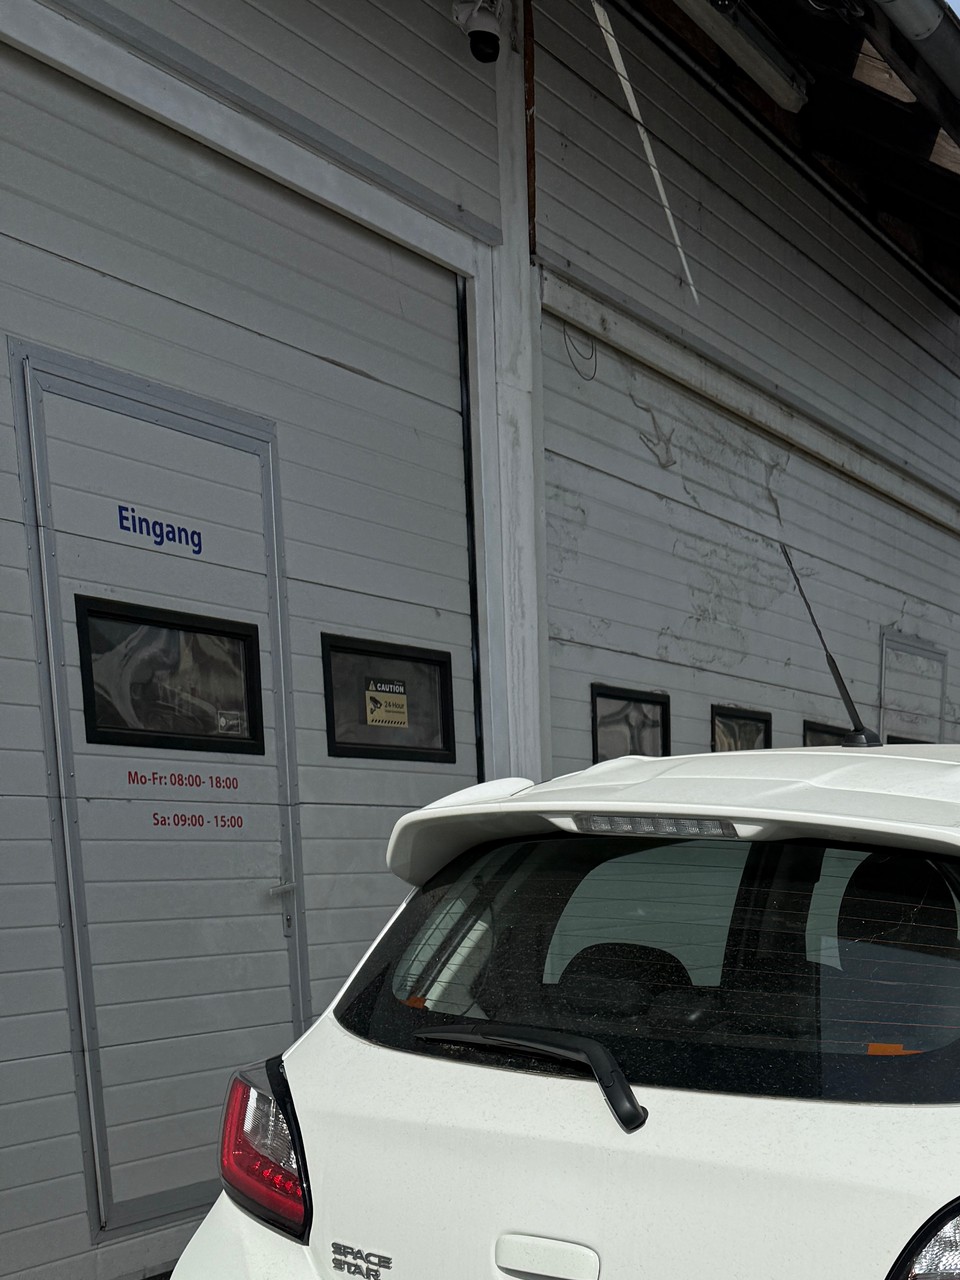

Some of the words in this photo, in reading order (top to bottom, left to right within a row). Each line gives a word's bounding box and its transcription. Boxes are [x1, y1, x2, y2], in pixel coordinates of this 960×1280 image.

[118, 505, 203, 554] Eingang
[377, 683, 404, 693] CAUTION
[127, 770, 168, 786] Mo-Fr:
[208, 776, 239, 790] 18:00
[152, 812, 171, 827] Sa:
[173, 813, 205, 828] 09:00
[214, 815, 244, 829] 15:00
[331, 1242, 393, 1270] SPACE
